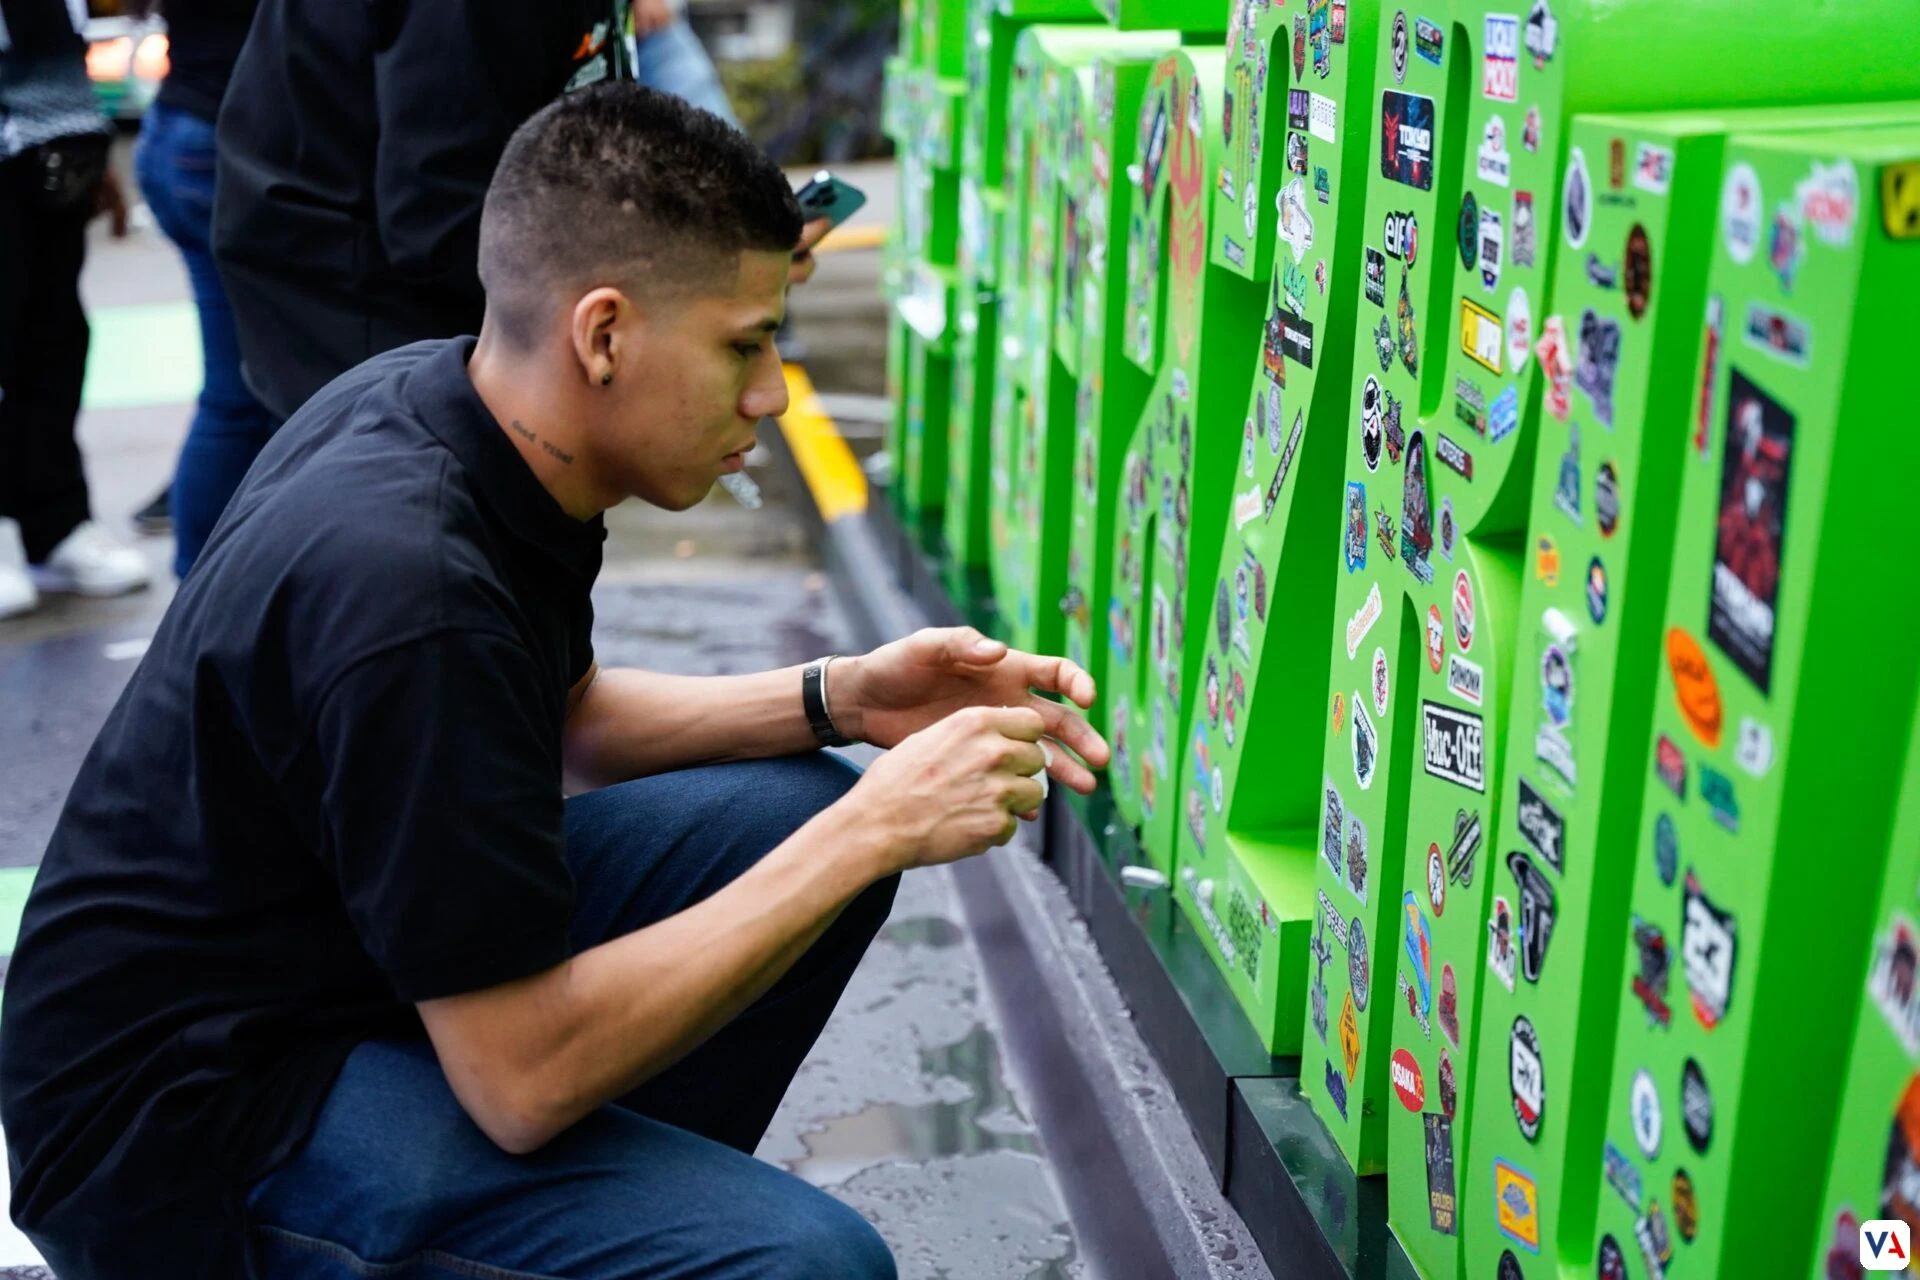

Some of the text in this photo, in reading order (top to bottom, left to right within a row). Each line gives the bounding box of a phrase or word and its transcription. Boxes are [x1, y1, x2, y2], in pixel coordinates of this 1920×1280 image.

[1384, 216, 1407, 255] elf
[1426, 717, 1482, 778] Muc-Off
[1391, 1060, 1416, 1095] OSAKA
